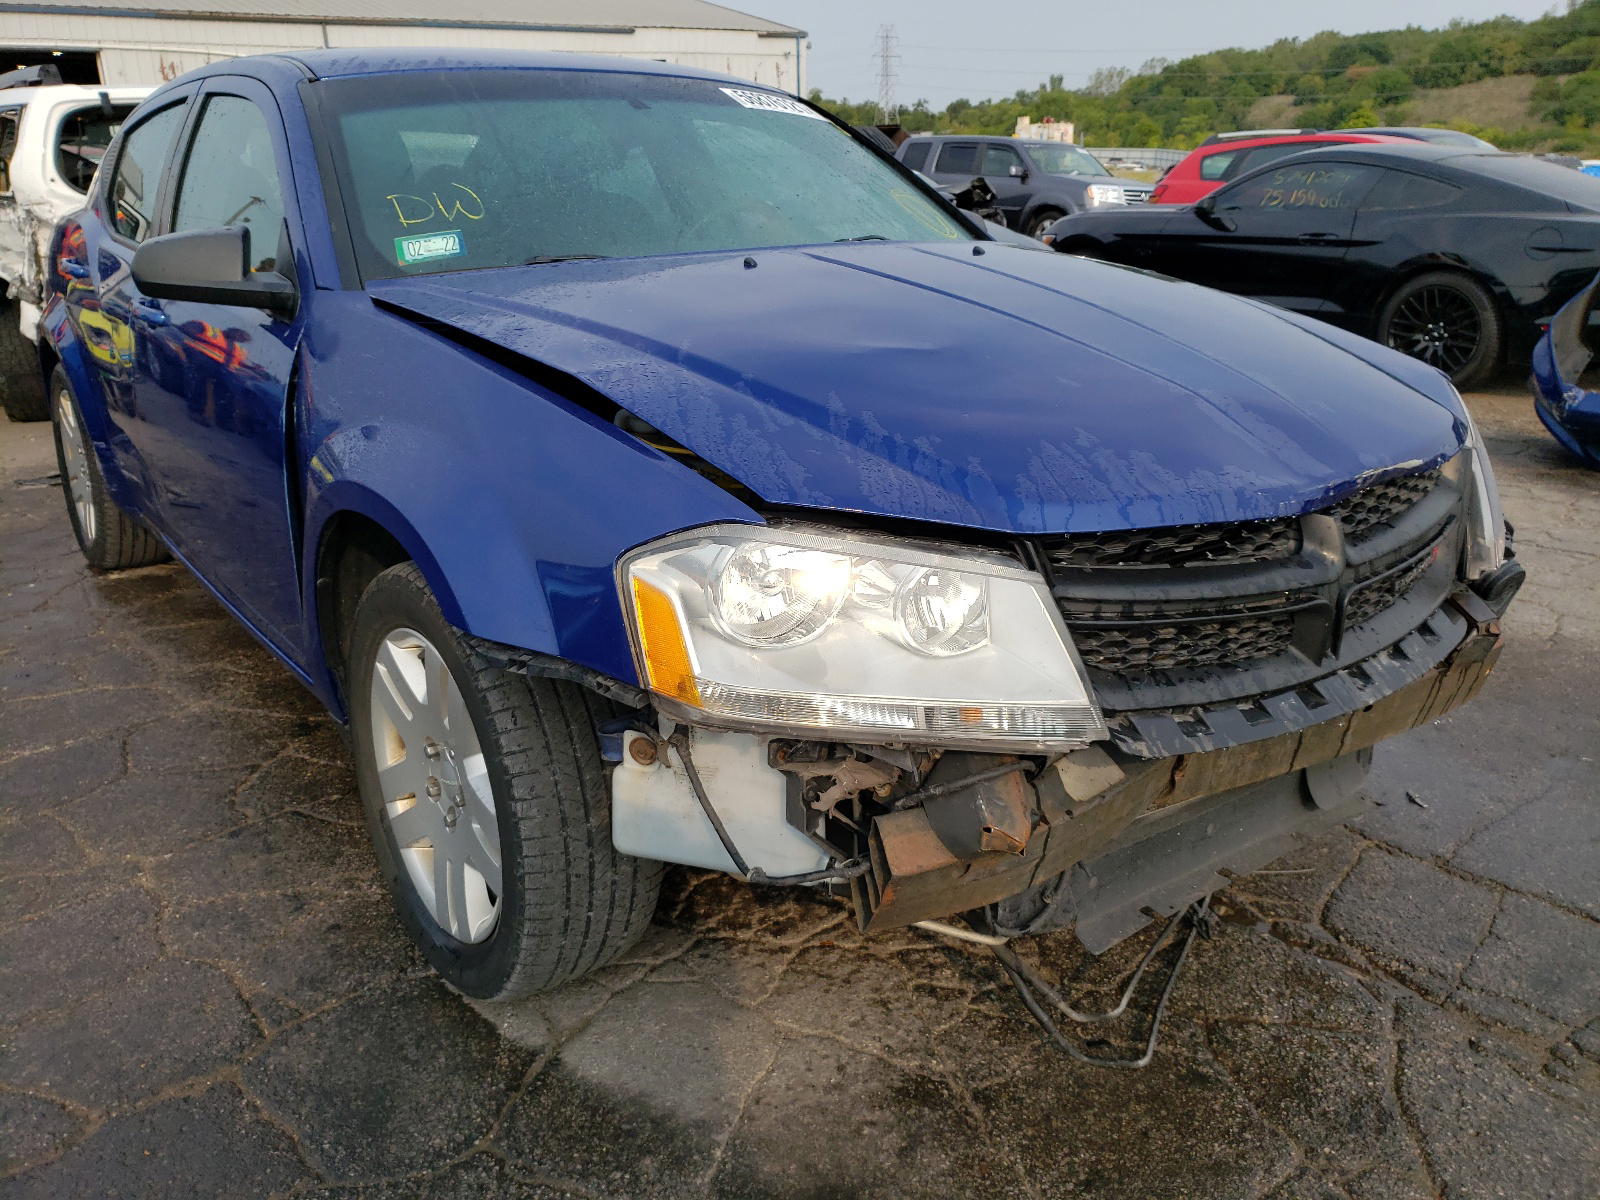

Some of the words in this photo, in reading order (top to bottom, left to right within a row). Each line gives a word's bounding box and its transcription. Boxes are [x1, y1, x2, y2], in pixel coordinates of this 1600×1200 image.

[386, 182, 485, 228] DW
[408, 240, 424, 256] 02
[442, 235, 458, 252] 22
